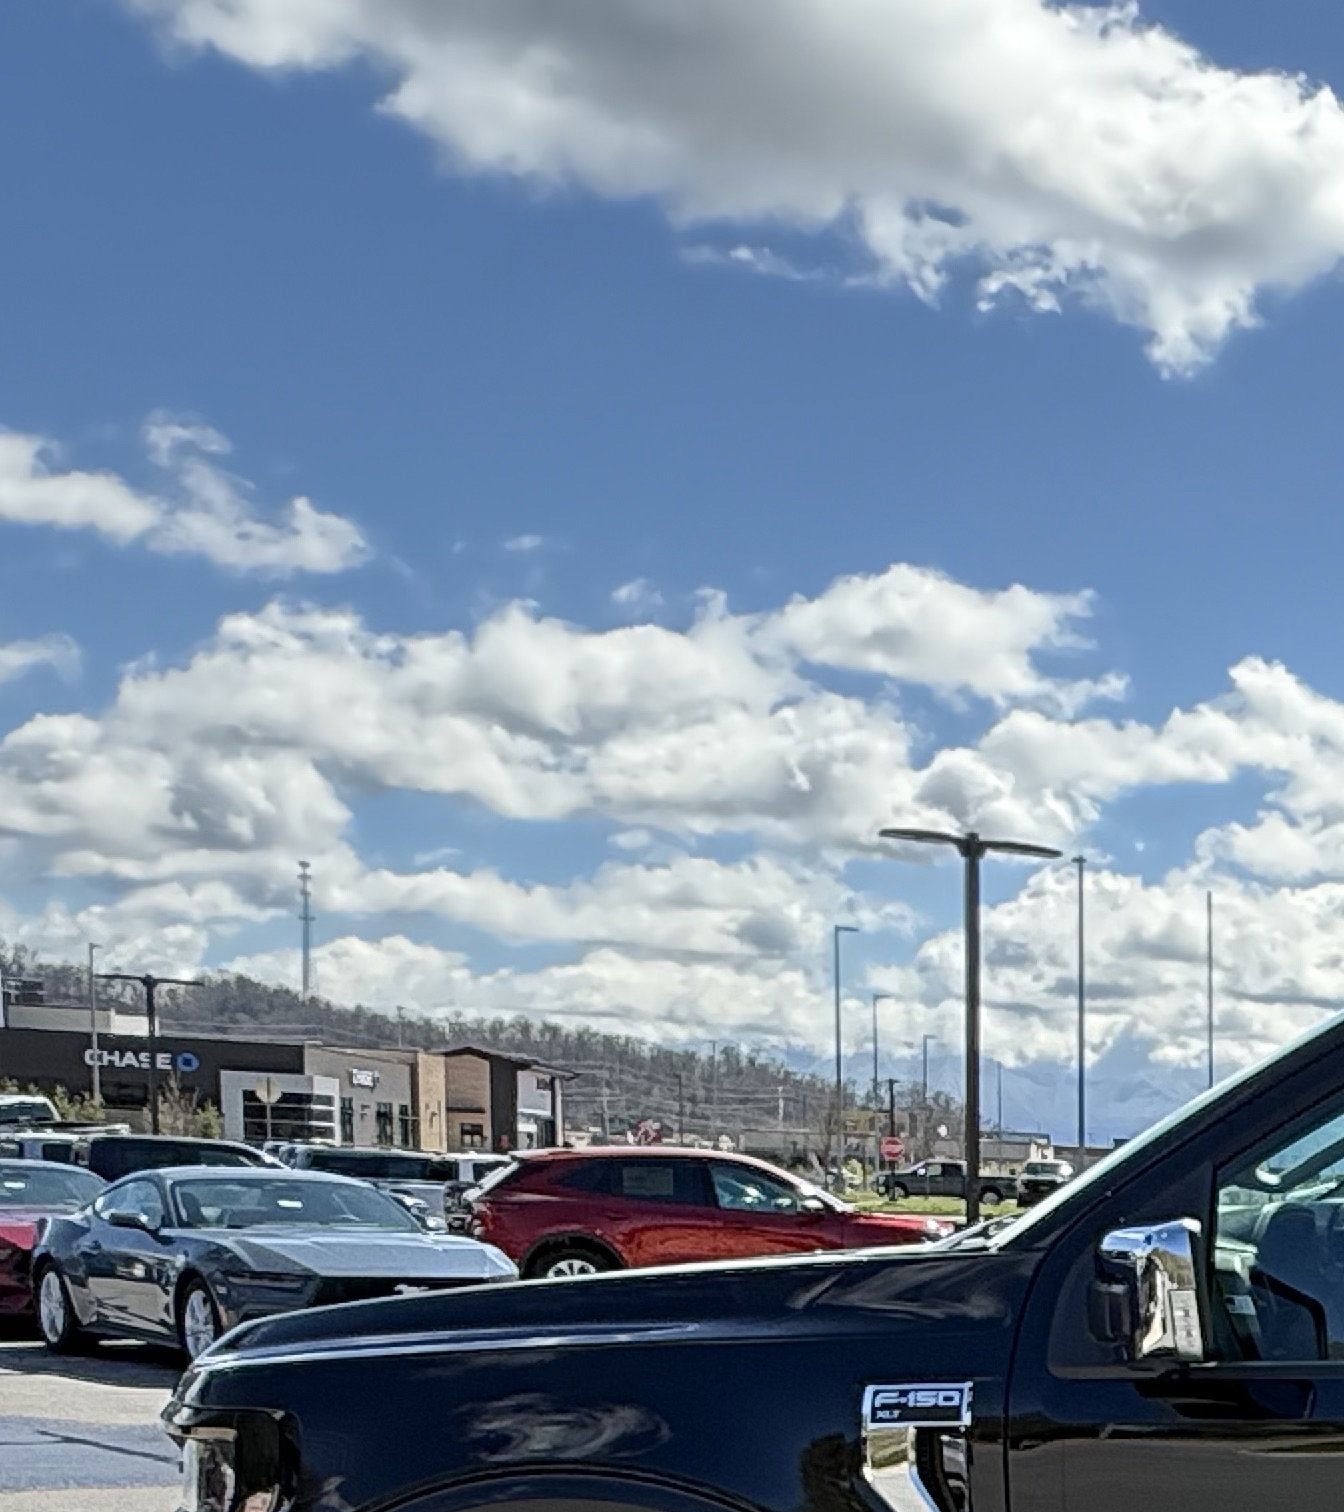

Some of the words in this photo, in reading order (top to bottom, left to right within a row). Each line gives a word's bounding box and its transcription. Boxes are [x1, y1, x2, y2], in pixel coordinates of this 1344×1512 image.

[84, 1048, 172, 1070] CHASE
[874, 1390, 960, 1408] F-150
[876, 1409, 901, 1420] XLT
